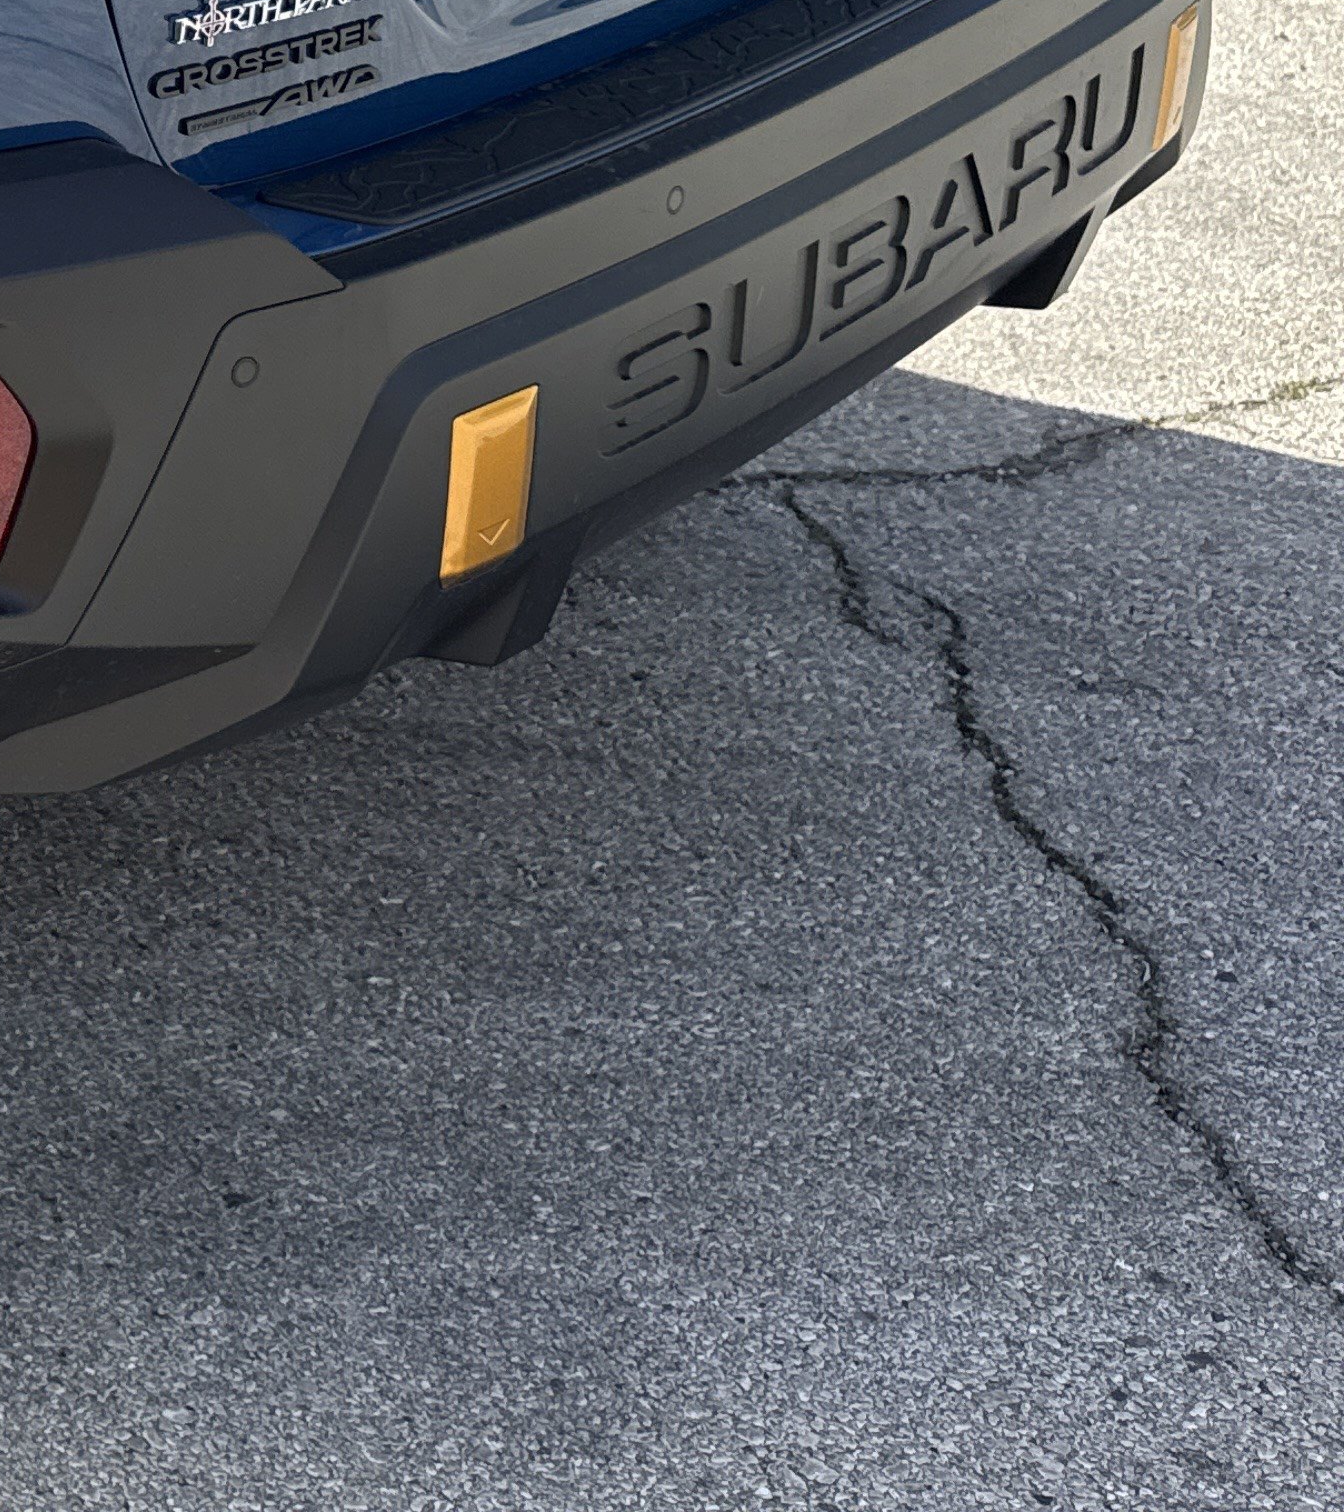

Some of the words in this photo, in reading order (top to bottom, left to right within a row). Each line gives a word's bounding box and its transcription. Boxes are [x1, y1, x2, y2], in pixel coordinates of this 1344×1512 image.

[147, 13, 384, 100] CROSSTREK
[260, 64, 383, 116] AWD
[600, 42, 1146, 460] SUBARU
